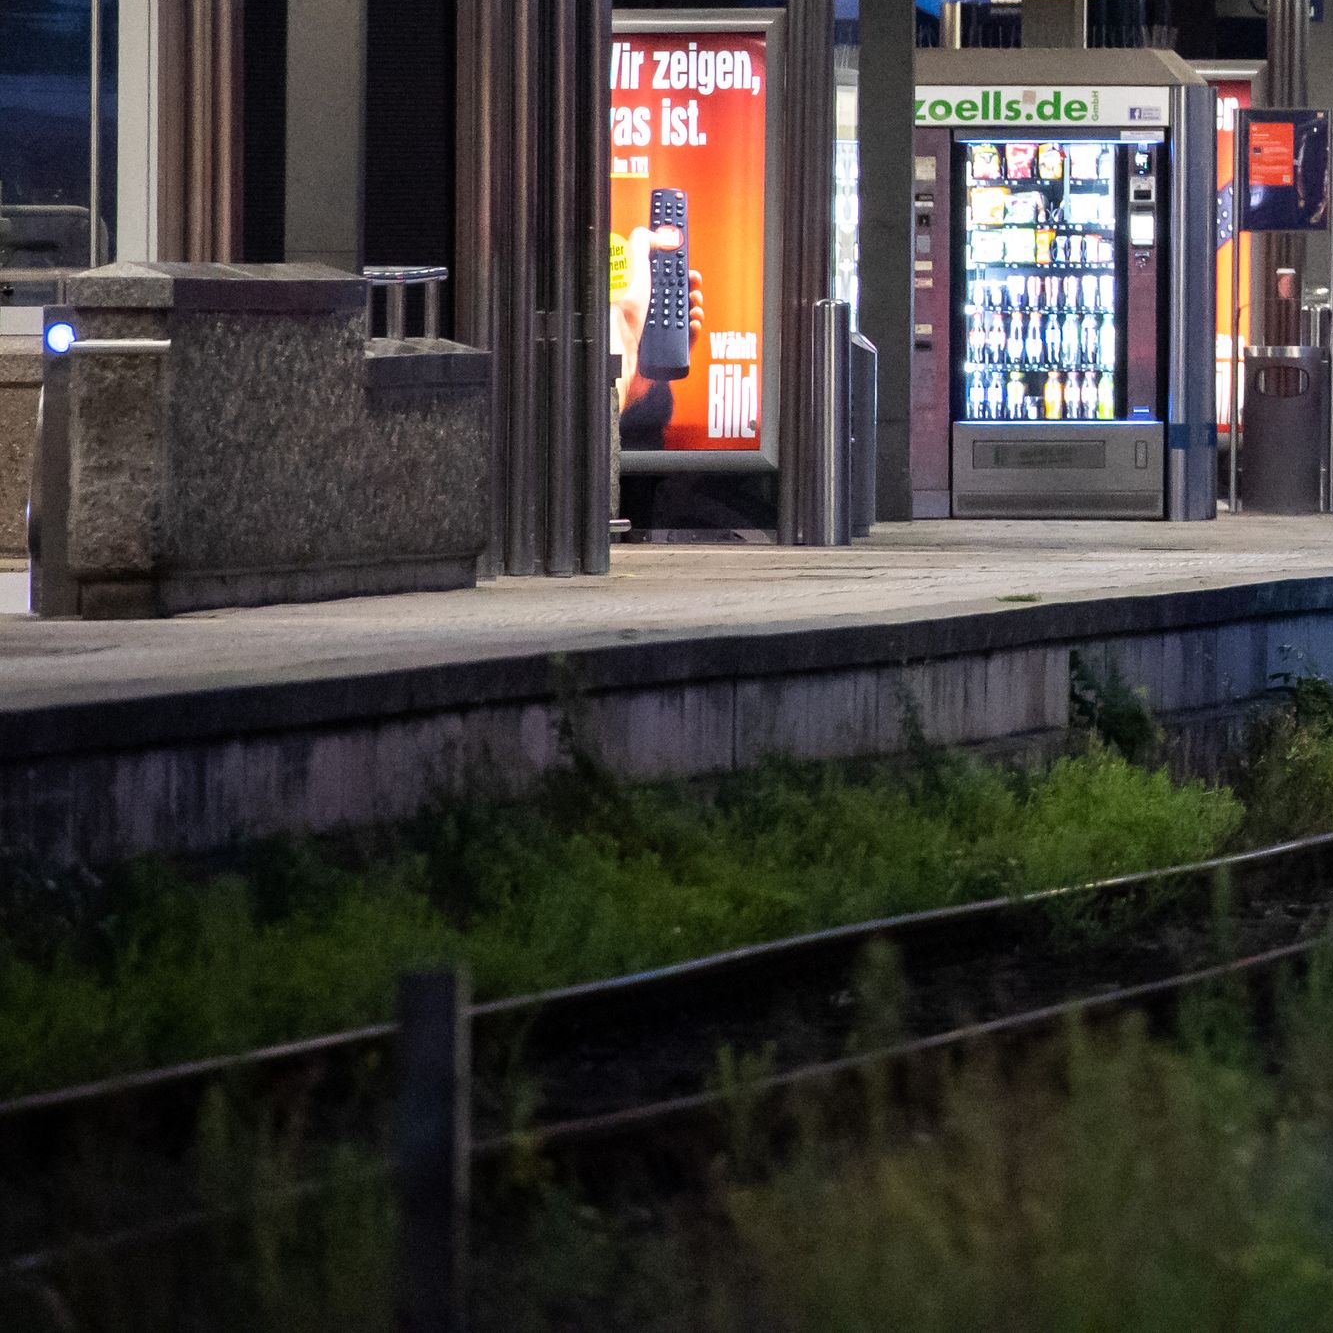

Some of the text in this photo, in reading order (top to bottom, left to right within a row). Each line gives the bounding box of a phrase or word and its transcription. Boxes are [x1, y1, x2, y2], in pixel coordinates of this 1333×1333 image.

[610, 42, 761, 95] ir zeigen,
[610, 98, 707, 146] as ist.
[709, 331, 757, 359] Wählt
